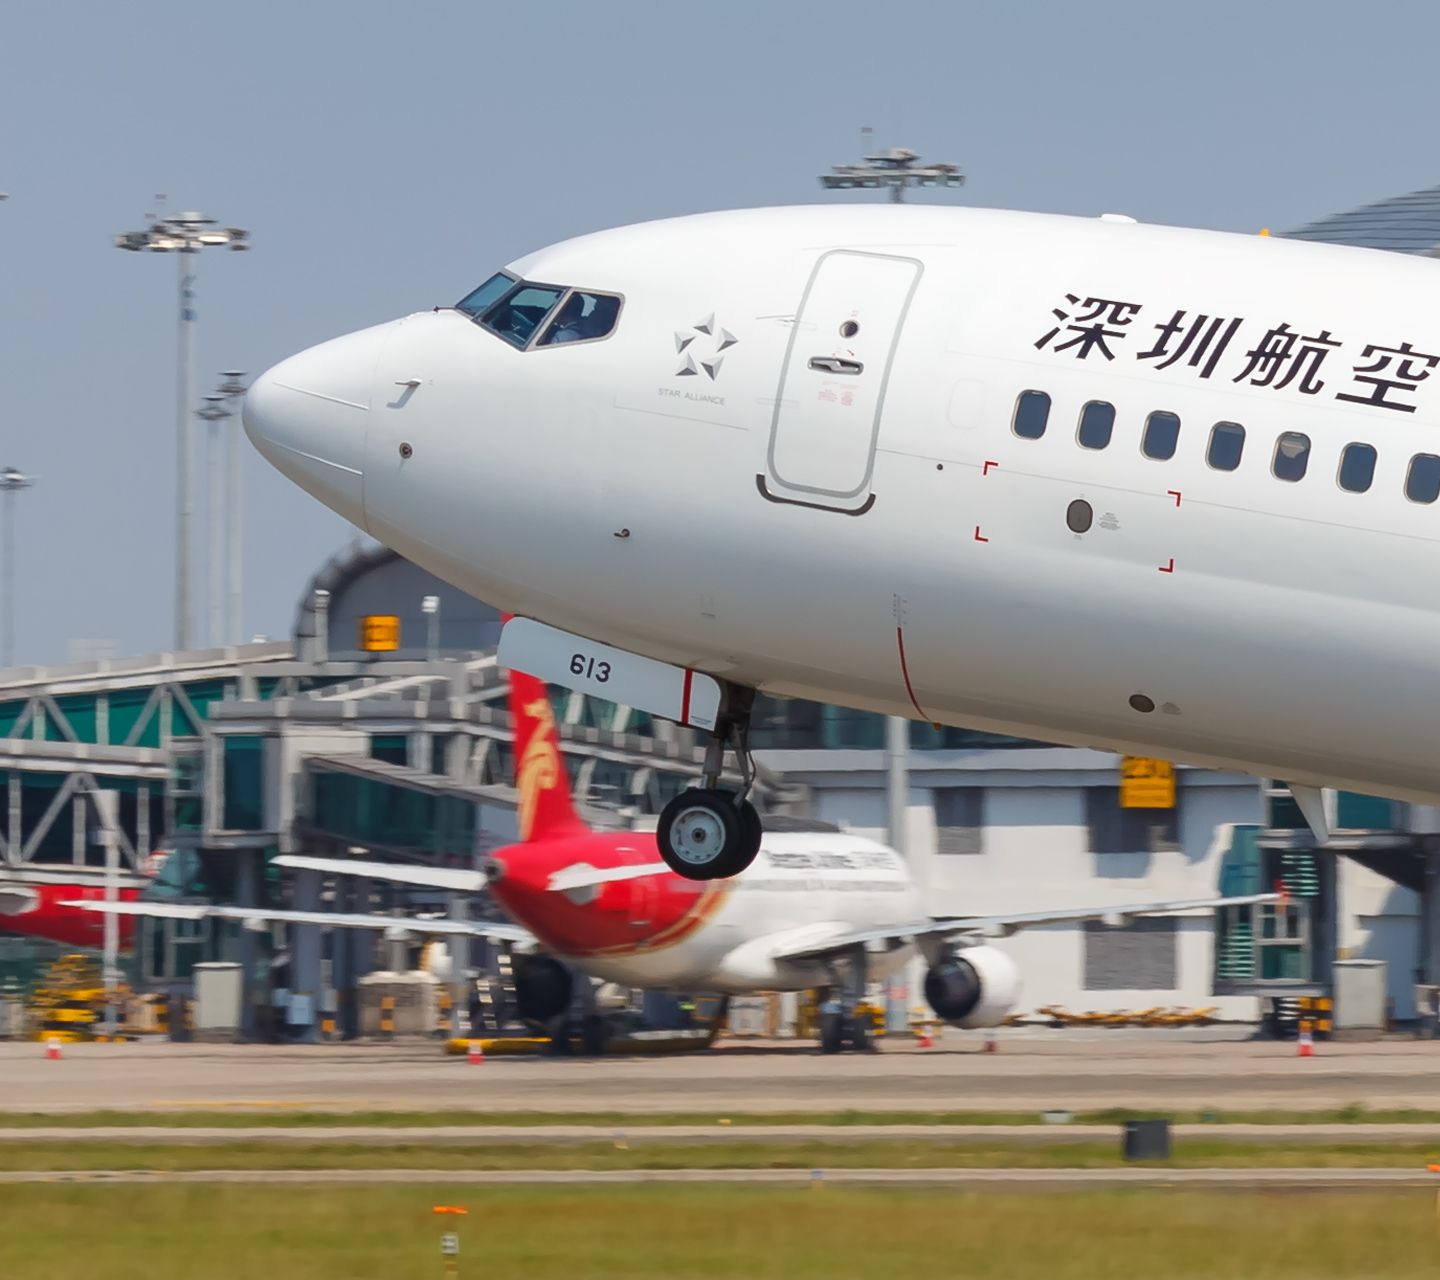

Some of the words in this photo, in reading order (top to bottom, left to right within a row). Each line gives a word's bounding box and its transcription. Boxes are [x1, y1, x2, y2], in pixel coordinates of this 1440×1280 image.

[658, 387, 681, 398] STAR
[684, 391, 725, 406] ALLIANCE
[569, 653, 612, 683] 613
